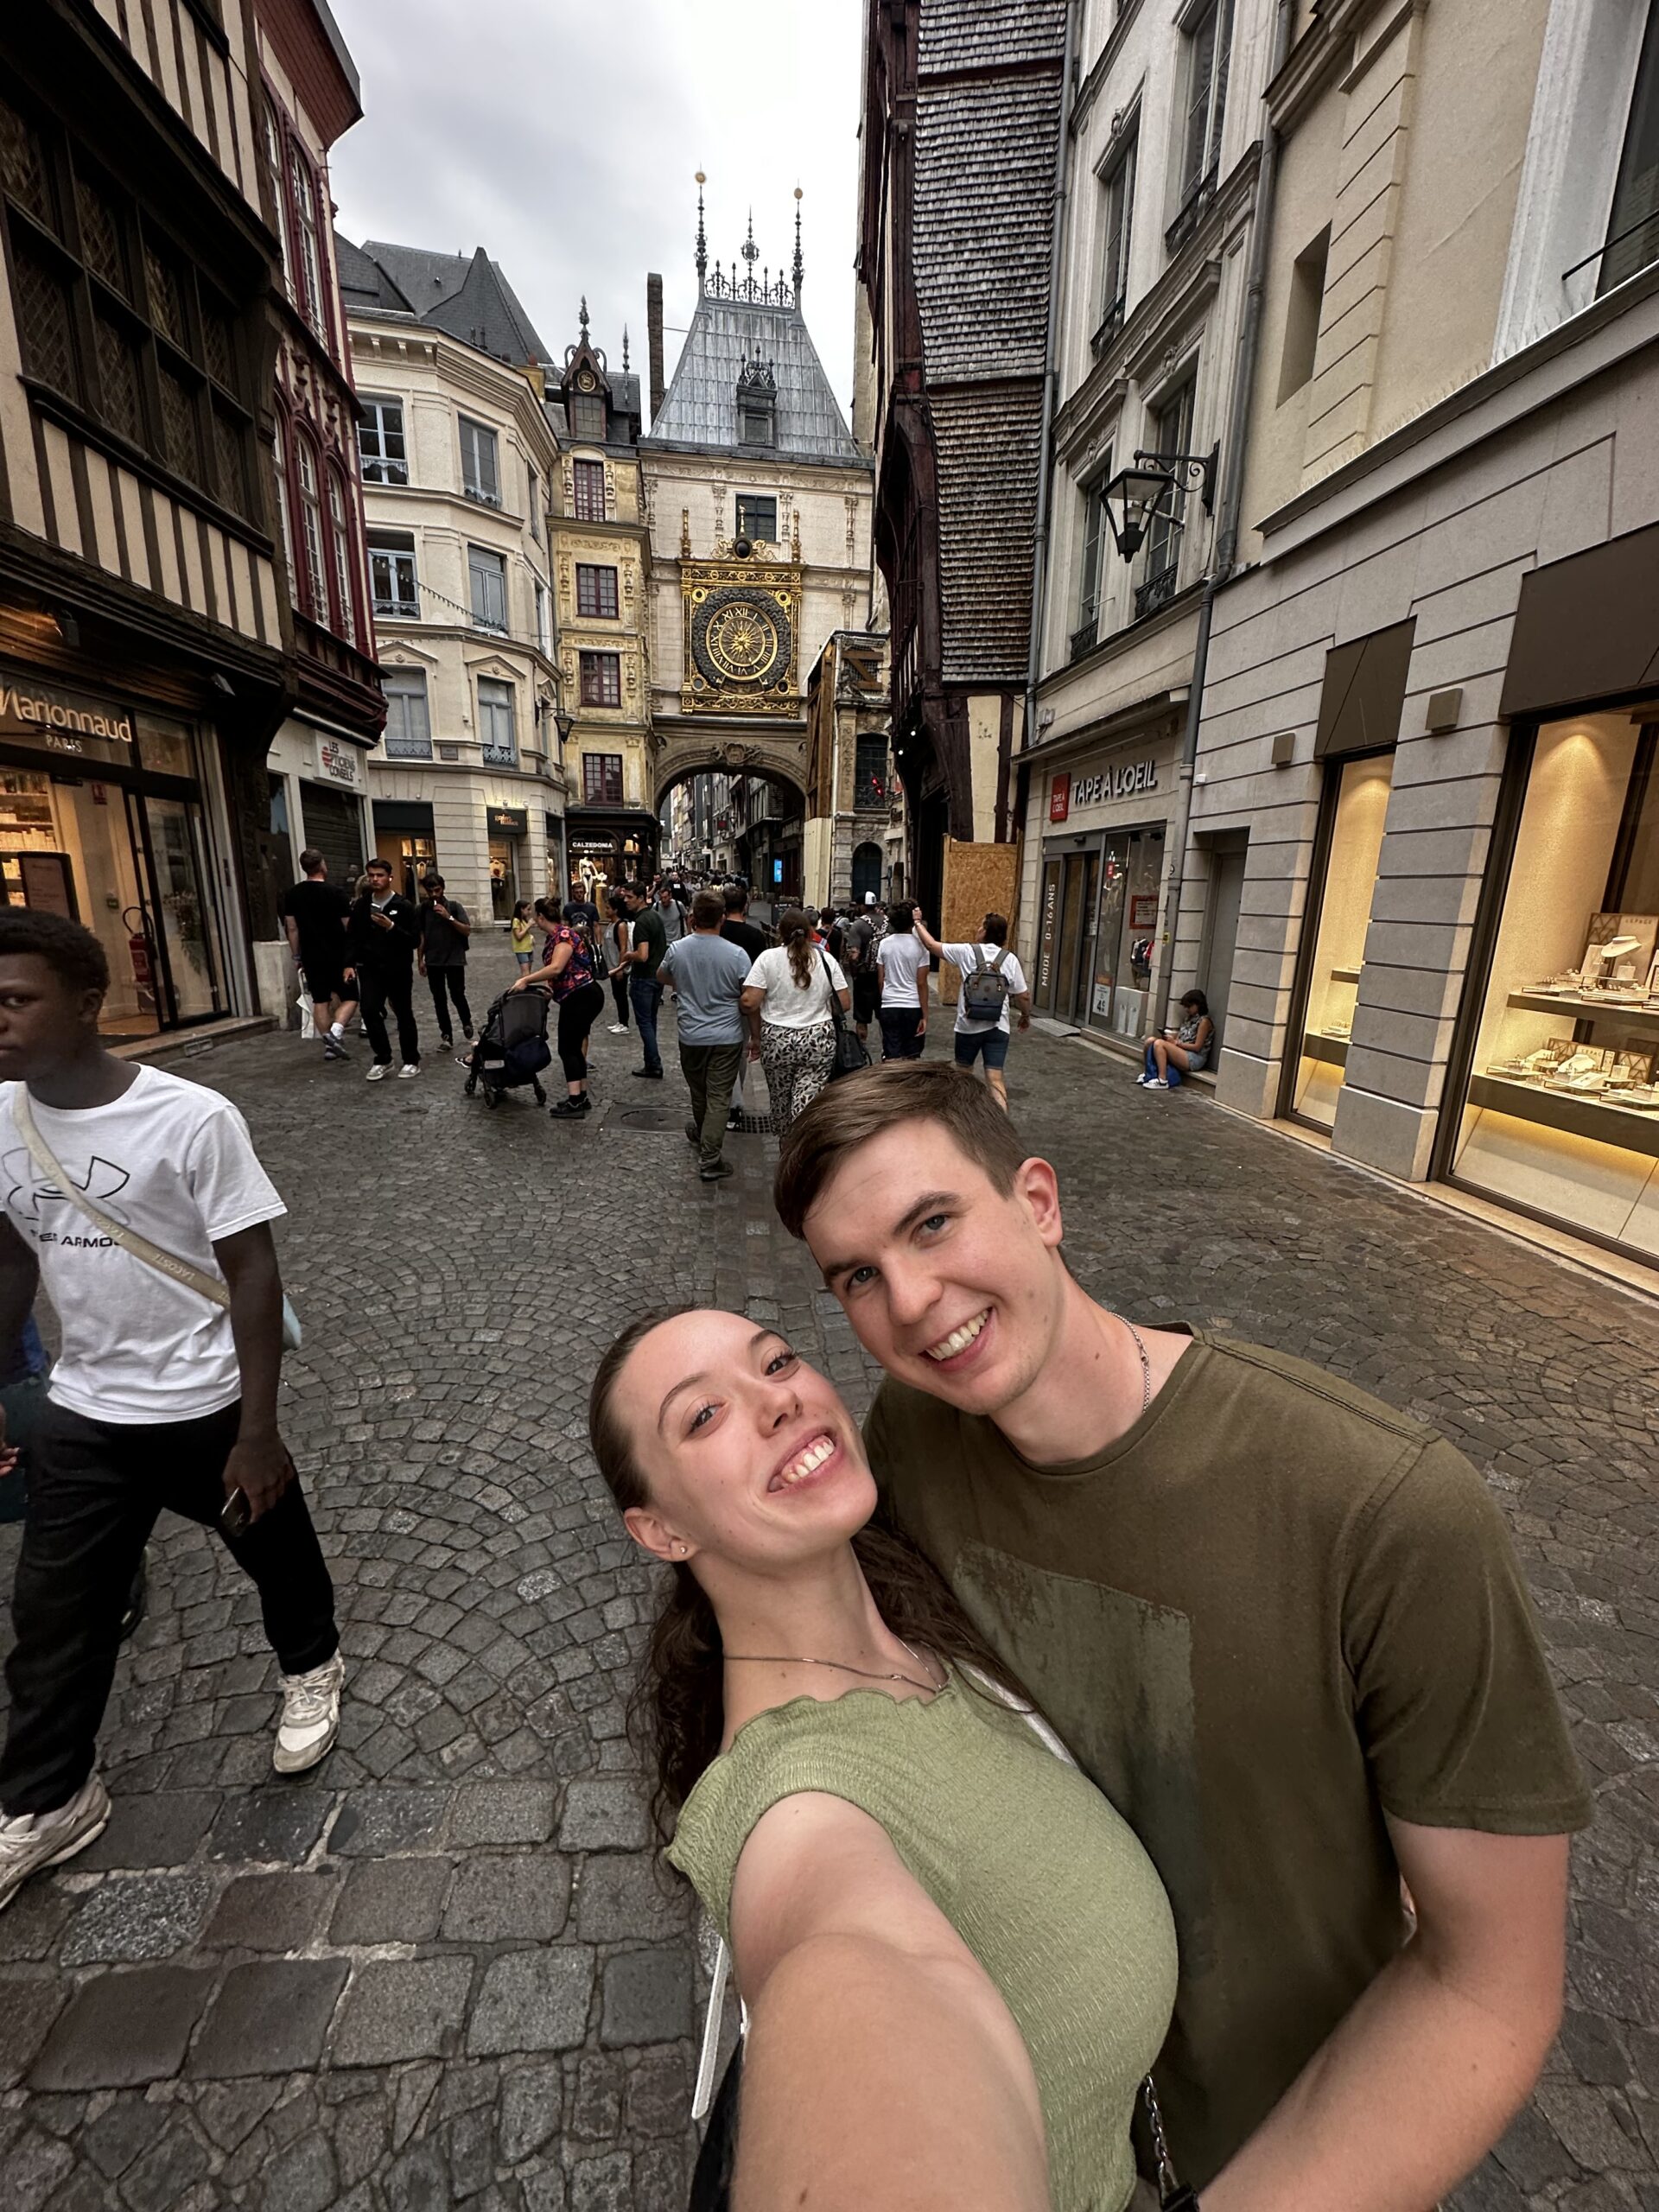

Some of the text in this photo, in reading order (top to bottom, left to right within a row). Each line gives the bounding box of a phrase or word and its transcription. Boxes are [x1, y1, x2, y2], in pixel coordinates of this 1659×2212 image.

[46, 734, 83, 753] PARIS
[1072, 774, 1102, 804] TAPE
[1115, 760, 1156, 795] L'OEIL
[1041, 952, 1051, 986] MODE
[1047, 884, 1056, 910] ANS
[151, 1254, 195, 1281] LACOSTE
